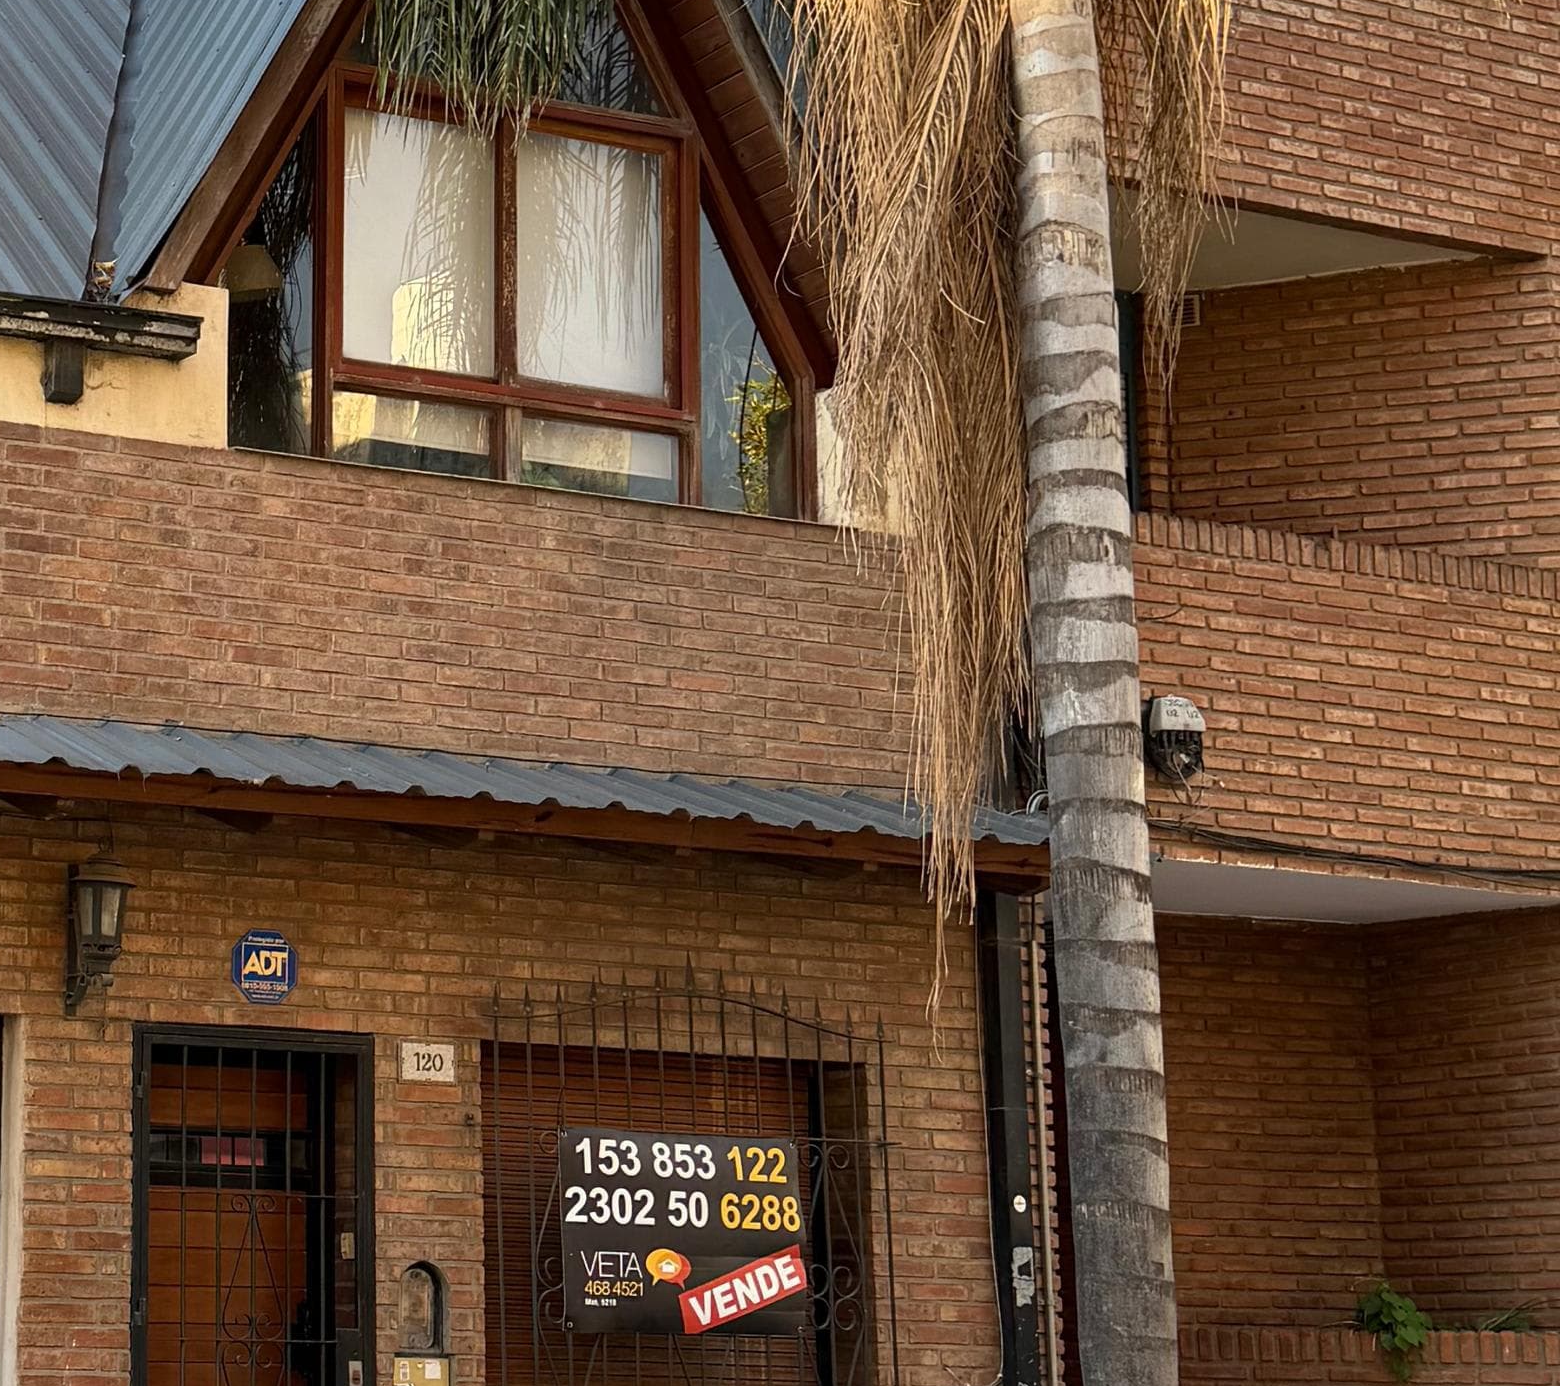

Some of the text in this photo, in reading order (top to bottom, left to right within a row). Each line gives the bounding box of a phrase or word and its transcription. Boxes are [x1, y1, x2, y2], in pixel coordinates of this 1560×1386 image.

[242, 950, 288, 977] ADT
[413, 1052, 444, 1072] 120
[575, 1137, 787, 1183] 153 853 122
[565, 1186, 801, 1232] 2302 50 6288
[580, 1250, 643, 1280] VETA
[584, 1280, 644, 1297] 468 4521
[688, 1255, 802, 1326] VENDE
